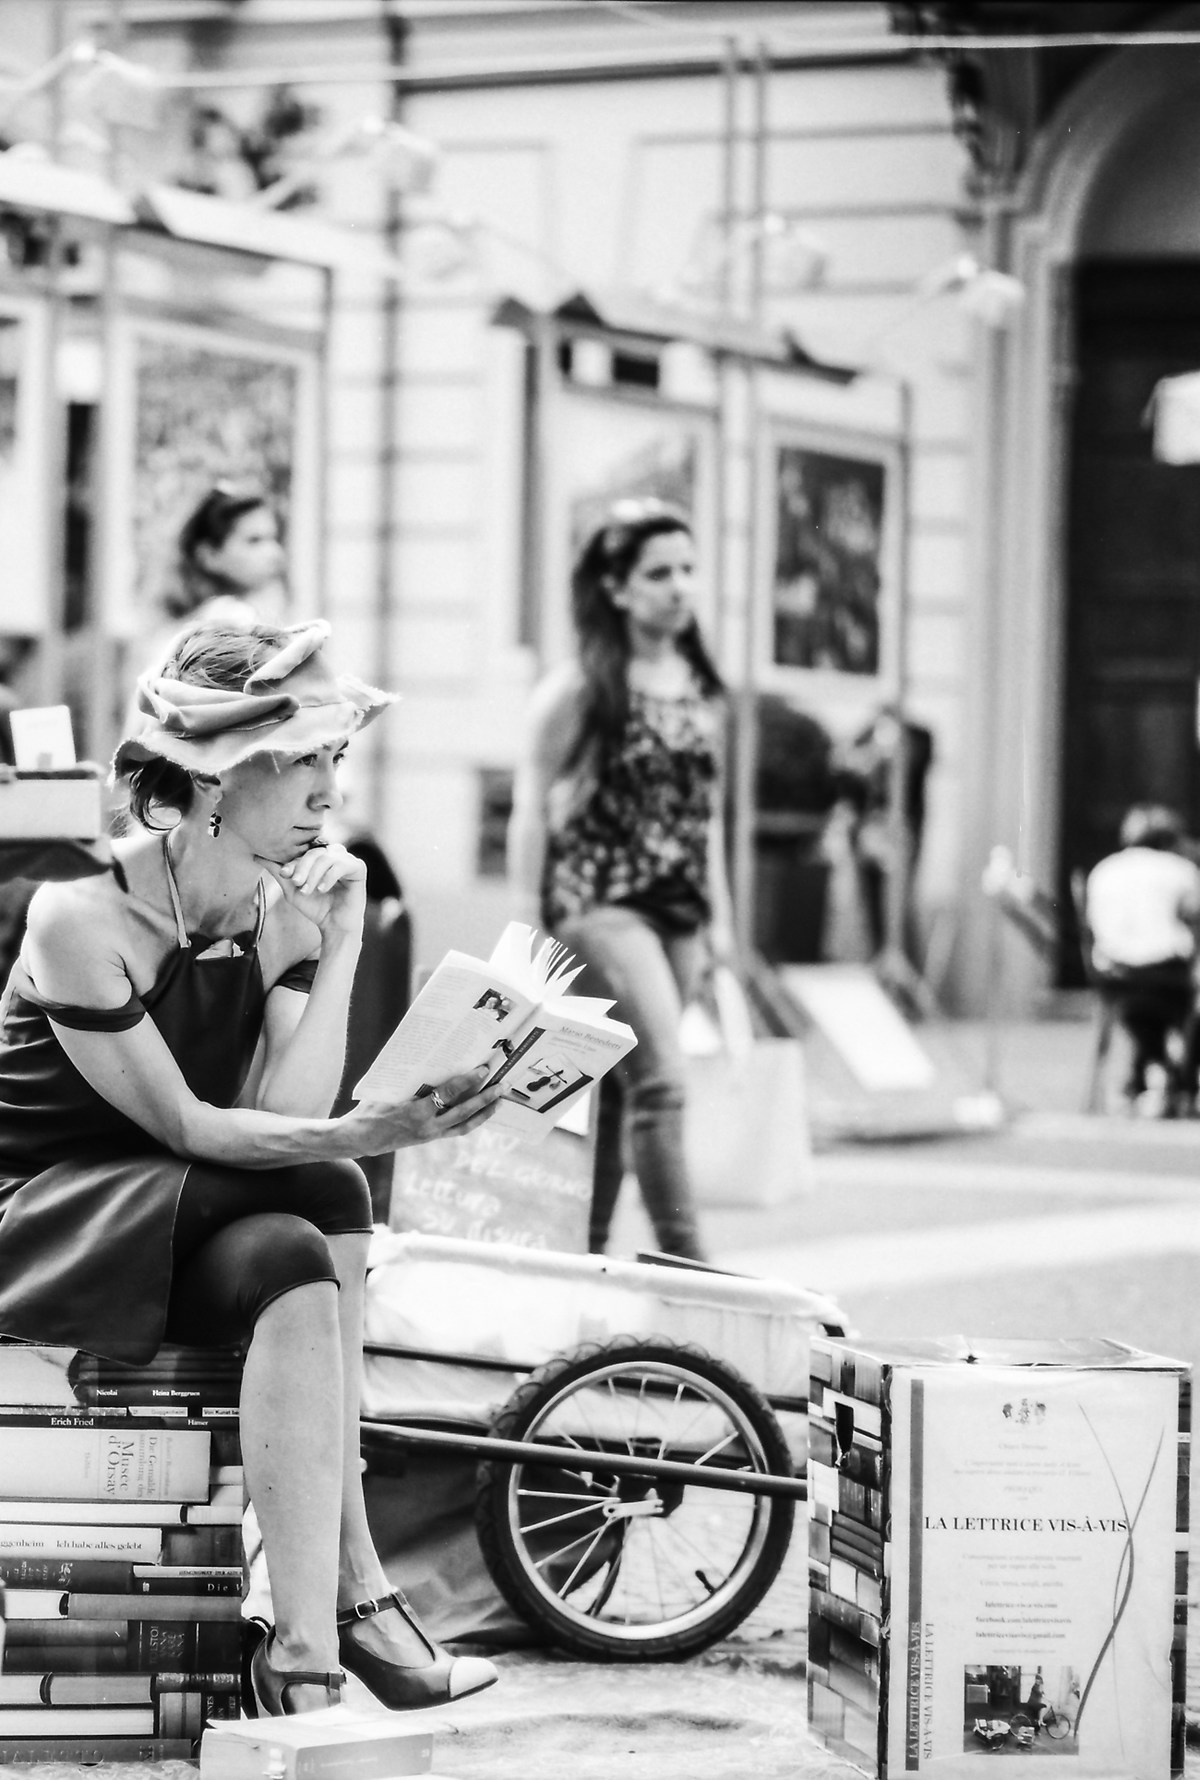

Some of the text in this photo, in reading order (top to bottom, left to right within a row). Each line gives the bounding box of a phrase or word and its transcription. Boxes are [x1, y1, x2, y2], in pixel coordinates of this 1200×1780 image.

[96, 1388, 118, 1397] Nicolai
[50, 1417, 94, 1426] Erich Fried
[924, 1515, 1129, 1534] LA LETTRICE VIS-À-VIS
[924, 1621, 934, 1638] LA
[924, 1640, 934, 1702] LETTRICE
[908, 1678, 921, 1741] LETTRICE
[908, 1741, 920, 1760] LA
